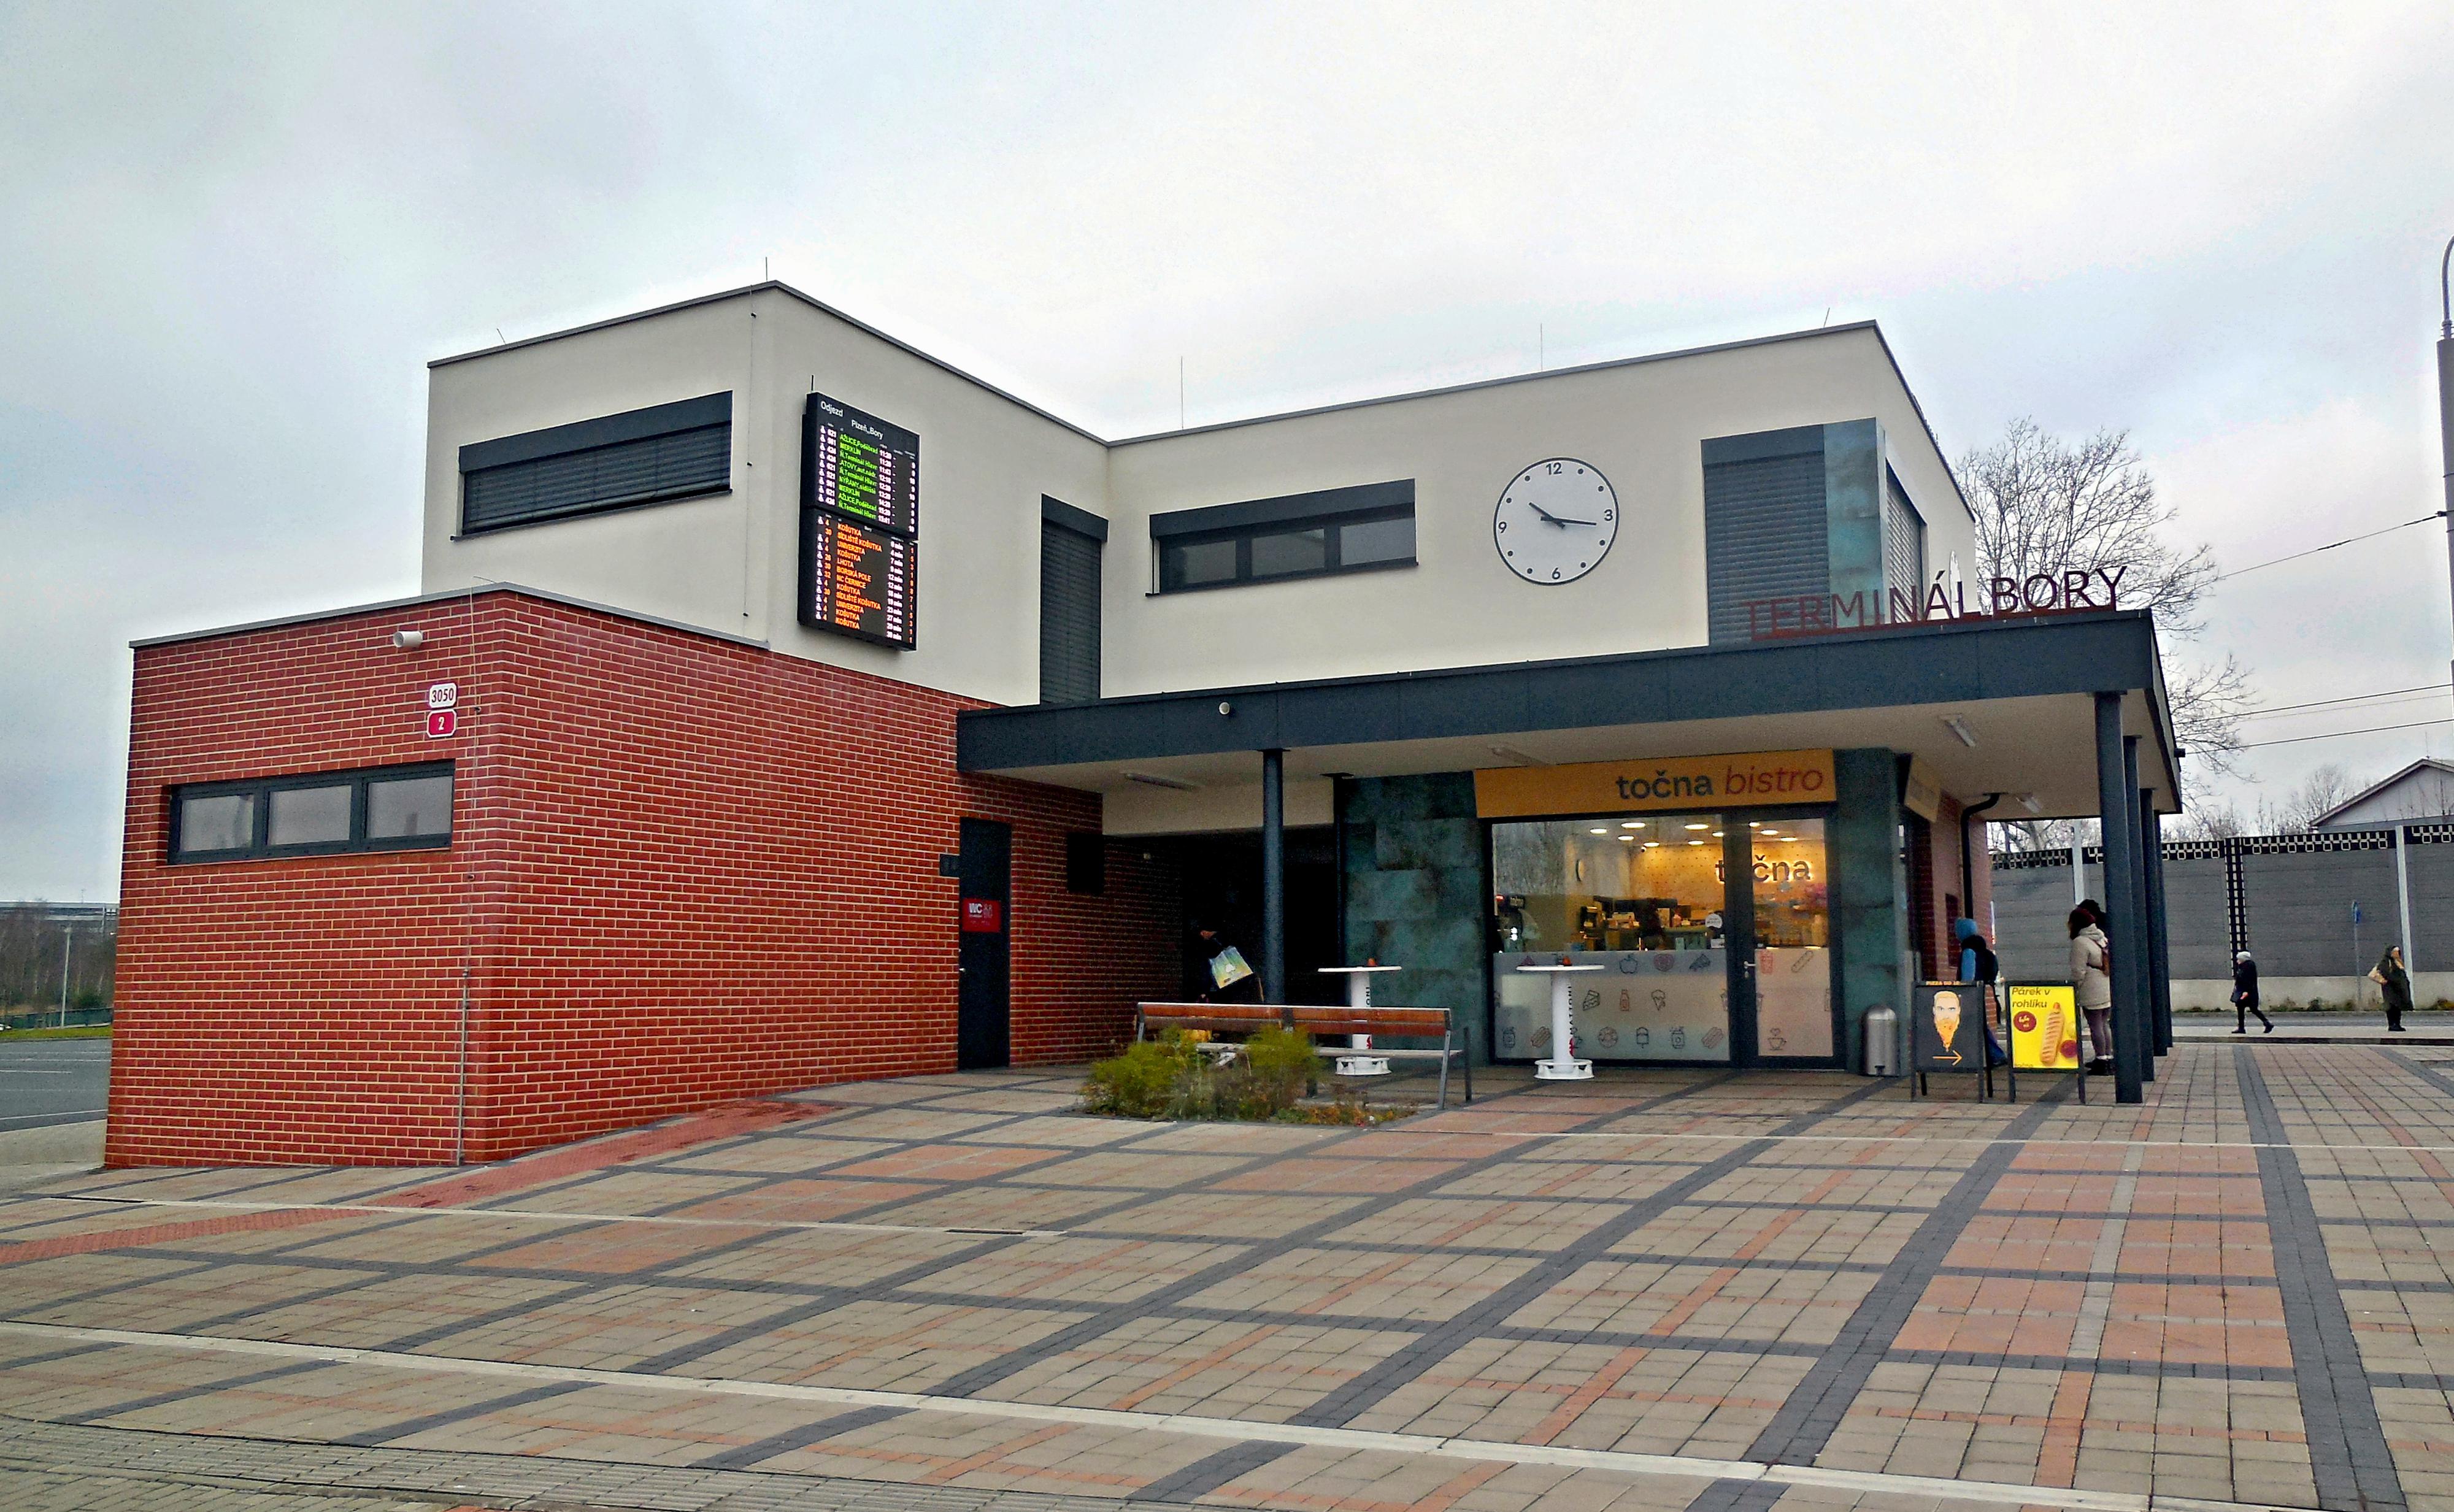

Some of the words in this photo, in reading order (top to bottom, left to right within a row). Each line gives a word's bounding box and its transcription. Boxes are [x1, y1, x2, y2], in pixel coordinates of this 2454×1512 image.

[821, 401, 843, 417] Odjezd
[1545, 462, 1562, 475] 12
[1604, 509, 1613, 521] 3
[838, 523, 861, 537] KOŠUTKA
[1498, 521, 1507, 534] 9
[837, 540, 865, 555] UNIVERZITA
[859, 539, 882, 551] KOŠUTKA
[837, 549, 861, 561] KOŠUTKA
[837, 558, 854, 568] LHOTA
[837, 566, 858, 578] BORSKÁ
[858, 572, 871, 581] POLE
[1552, 567, 1561, 580] 6
[845, 576, 866, 588] ČERNICE
[837, 583, 860, 596] KOŠUTKA
[836, 600, 864, 613] UNIVERZITA
[858, 597, 881, 610] KOŠUTKA
[1741, 570, 1981, 638] TERMINÁL
[1991, 565, 2128, 616] BORY
[836, 608, 860, 620] KOŠUTKA
[835, 617, 860, 629] KOŠUTKA
[431, 688, 454, 703] 3050
[438, 716, 445, 731] 2
[1616, 770, 1714, 799] točna
[1725, 765, 1824, 795] bistro
[1715, 854, 1811, 882] tčna
[969, 902, 983, 913] WC
[2012, 986, 2041, 996] Párek
[2012, 999, 2047, 1008] rohlíku
